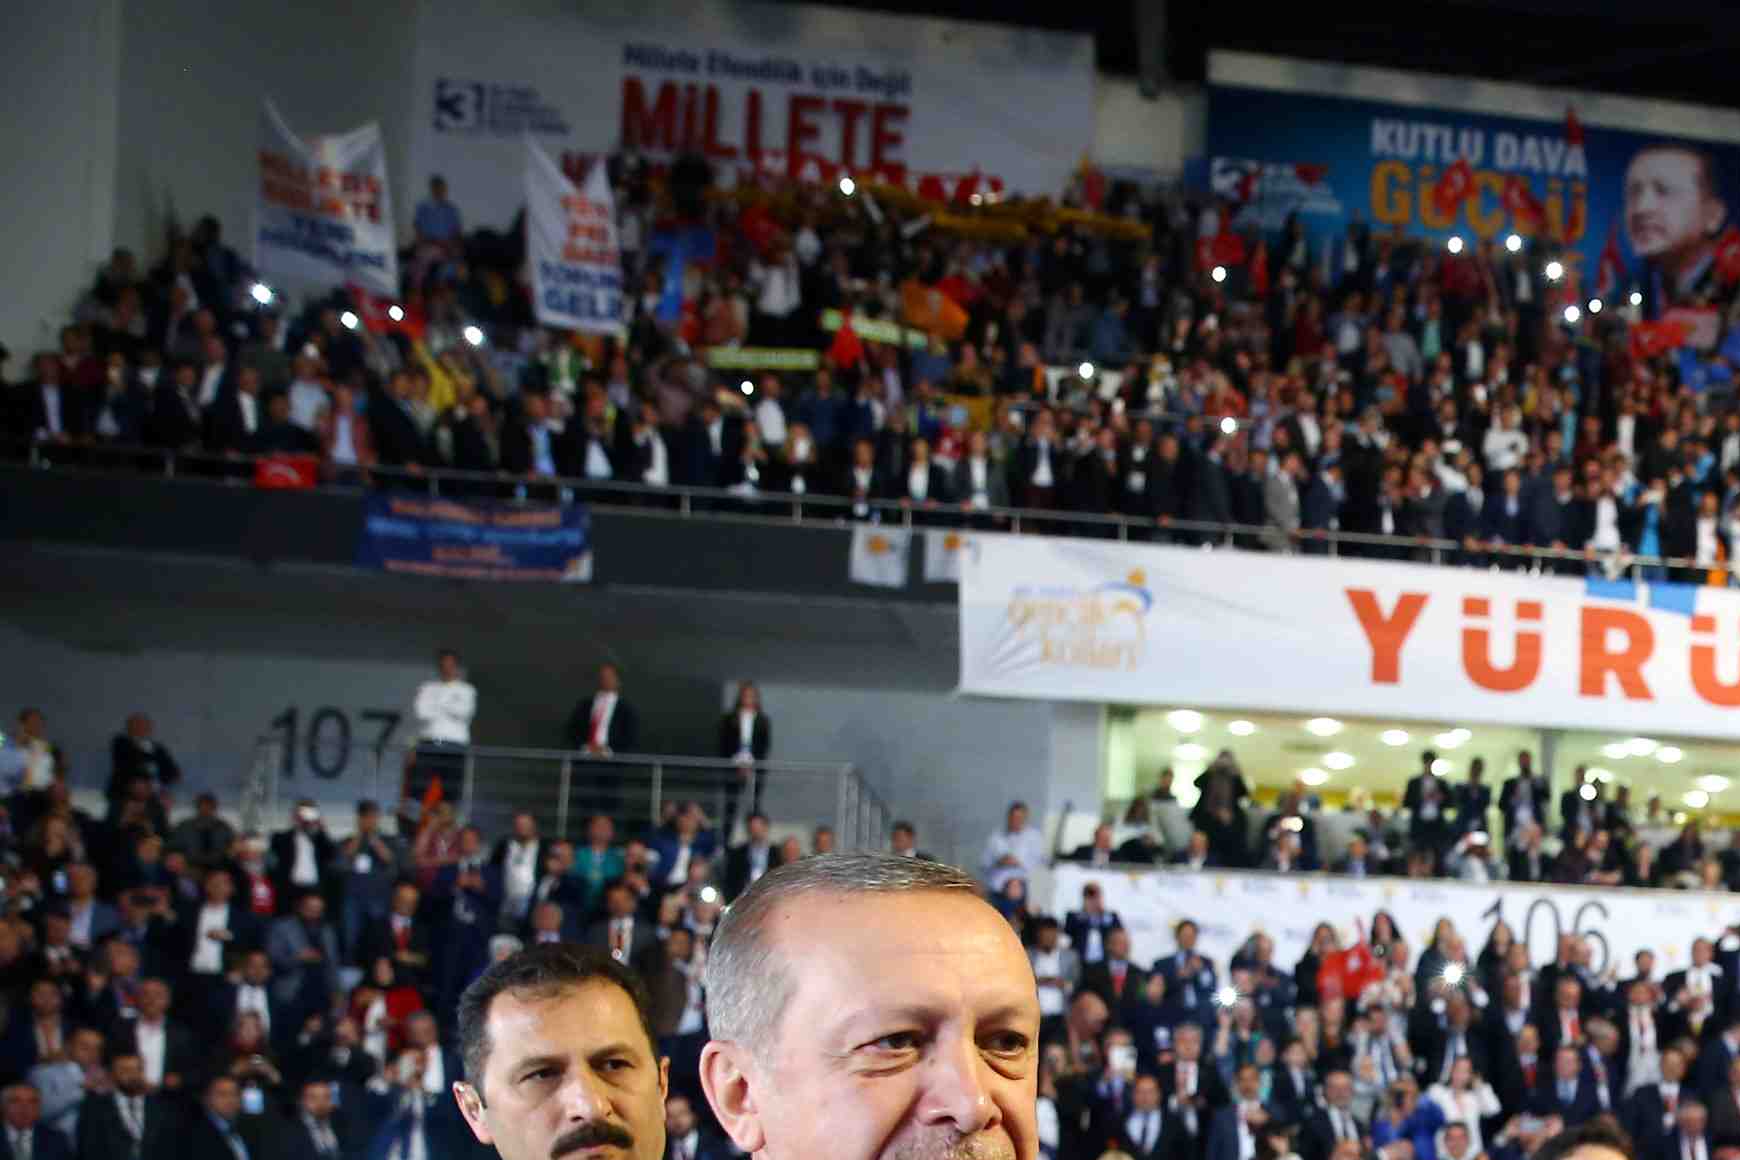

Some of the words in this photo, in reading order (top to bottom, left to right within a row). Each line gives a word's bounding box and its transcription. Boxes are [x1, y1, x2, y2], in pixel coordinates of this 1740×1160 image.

[1371, 117, 1485, 167] KUTLU
[1493, 132, 1588, 178] DAVA
[271, 706, 403, 780] 107
